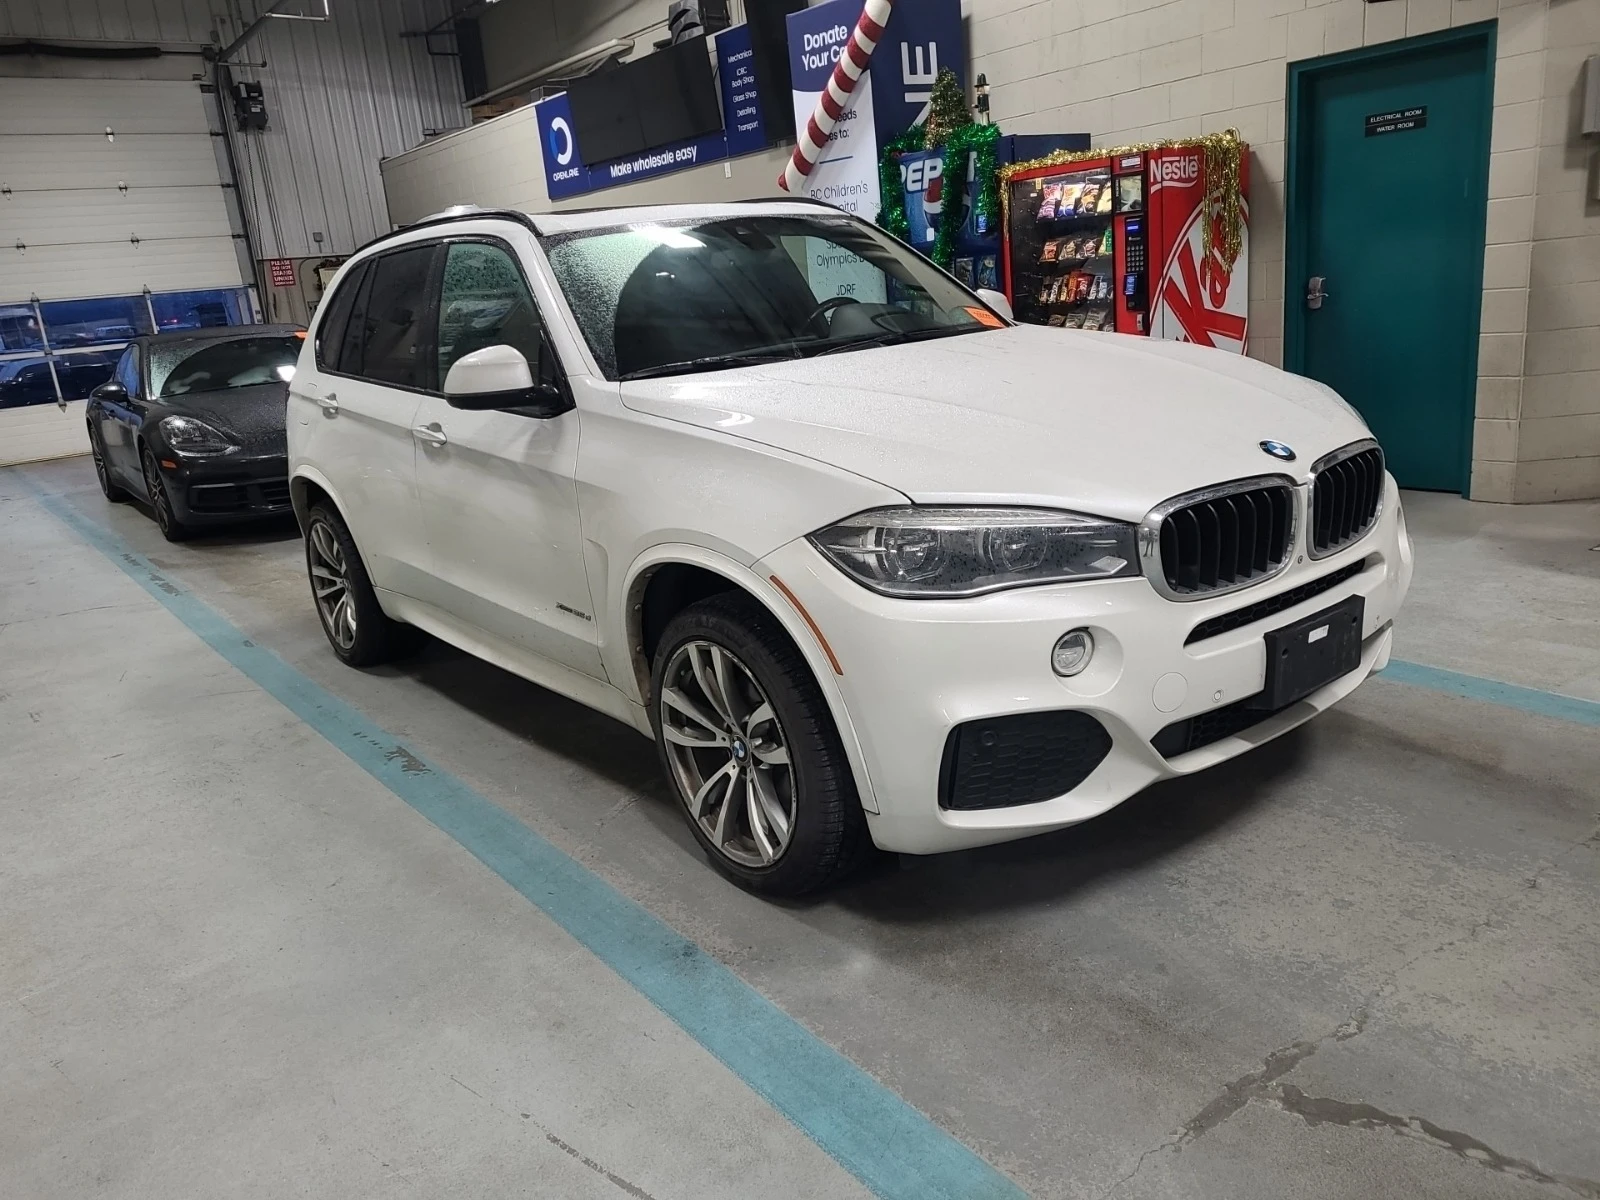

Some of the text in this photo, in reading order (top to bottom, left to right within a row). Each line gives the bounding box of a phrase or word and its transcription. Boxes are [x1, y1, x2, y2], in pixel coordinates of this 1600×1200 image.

[803, 25, 848, 51] Donate
[727, 48, 753, 64] Mechanical
[802, 50, 831, 71] Your
[731, 75, 755, 88] Body Shop
[732, 90, 757, 103] Glass Shop
[736, 106, 757, 118] Detailing
[1370, 109, 1423, 123] ELECTRICAL ROOM
[737, 120, 759, 132] Transport
[839, 128, 849, 139] to:
[609, 145, 698, 178] Make wholesale easy
[552, 167, 580, 182] OPENLANE
[823, 180, 869, 199] Children's
[816, 252, 857, 268] Olympics
[835, 283, 856, 296] JDRF
